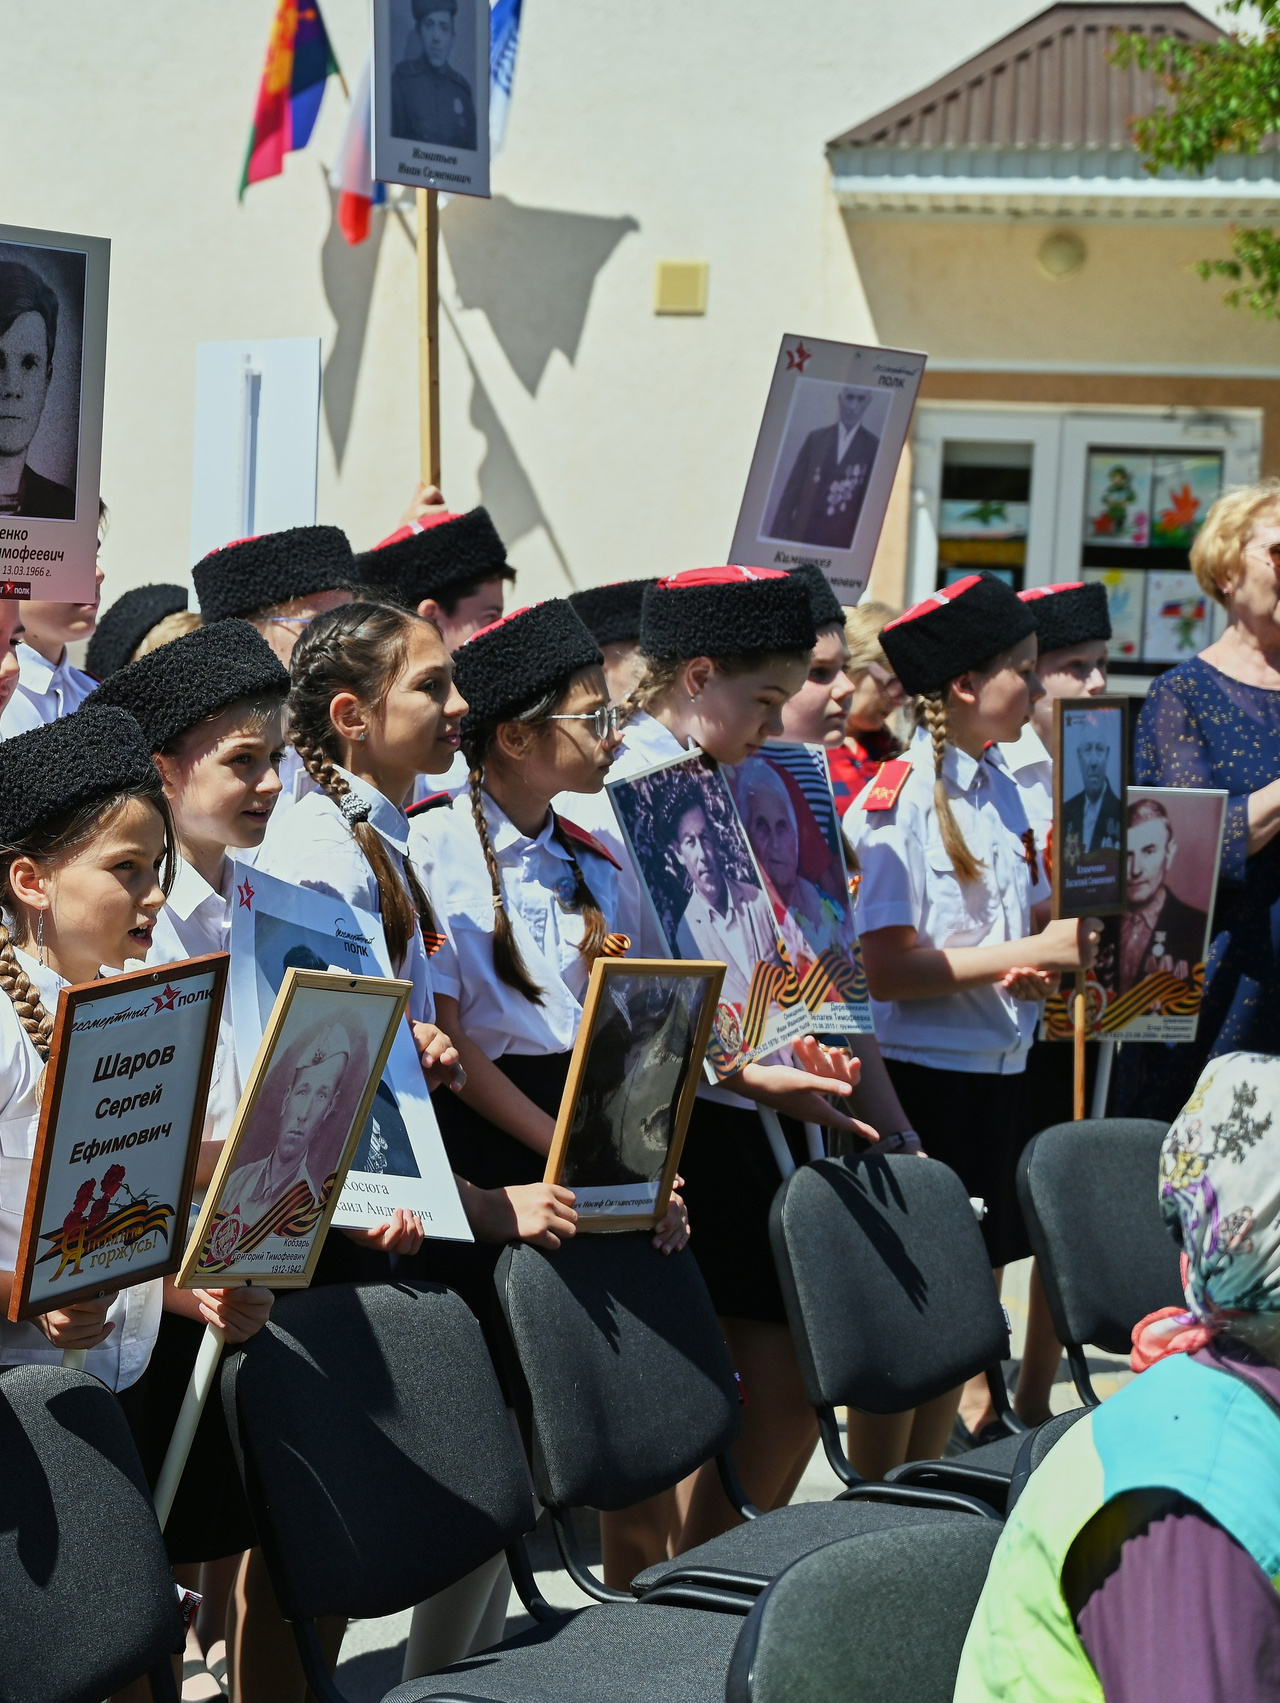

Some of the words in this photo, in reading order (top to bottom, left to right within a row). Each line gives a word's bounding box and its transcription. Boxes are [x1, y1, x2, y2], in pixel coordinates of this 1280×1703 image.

[2, 564, 45, 577] 13.03.1966
[344, 941, 369, 957] ПОЛК
[71, 1003, 155, 1033] ессмертный
[178, 989, 214, 1008] ПОЛК
[92, 1045, 177, 1083] Шаров
[95, 1084, 164, 1121] Сергей
[69, 1121, 174, 1165] Ефимович
[367, 1201, 434, 1221] Андвич
[48, 1222, 90, 1282] Я
[90, 1230, 159, 1269] горжусь!
[233, 1250, 265, 1262] Григорий
[266, 1251, 307, 1263] Тимофеевич
[282, 1237, 311, 1250] Кобзарь
